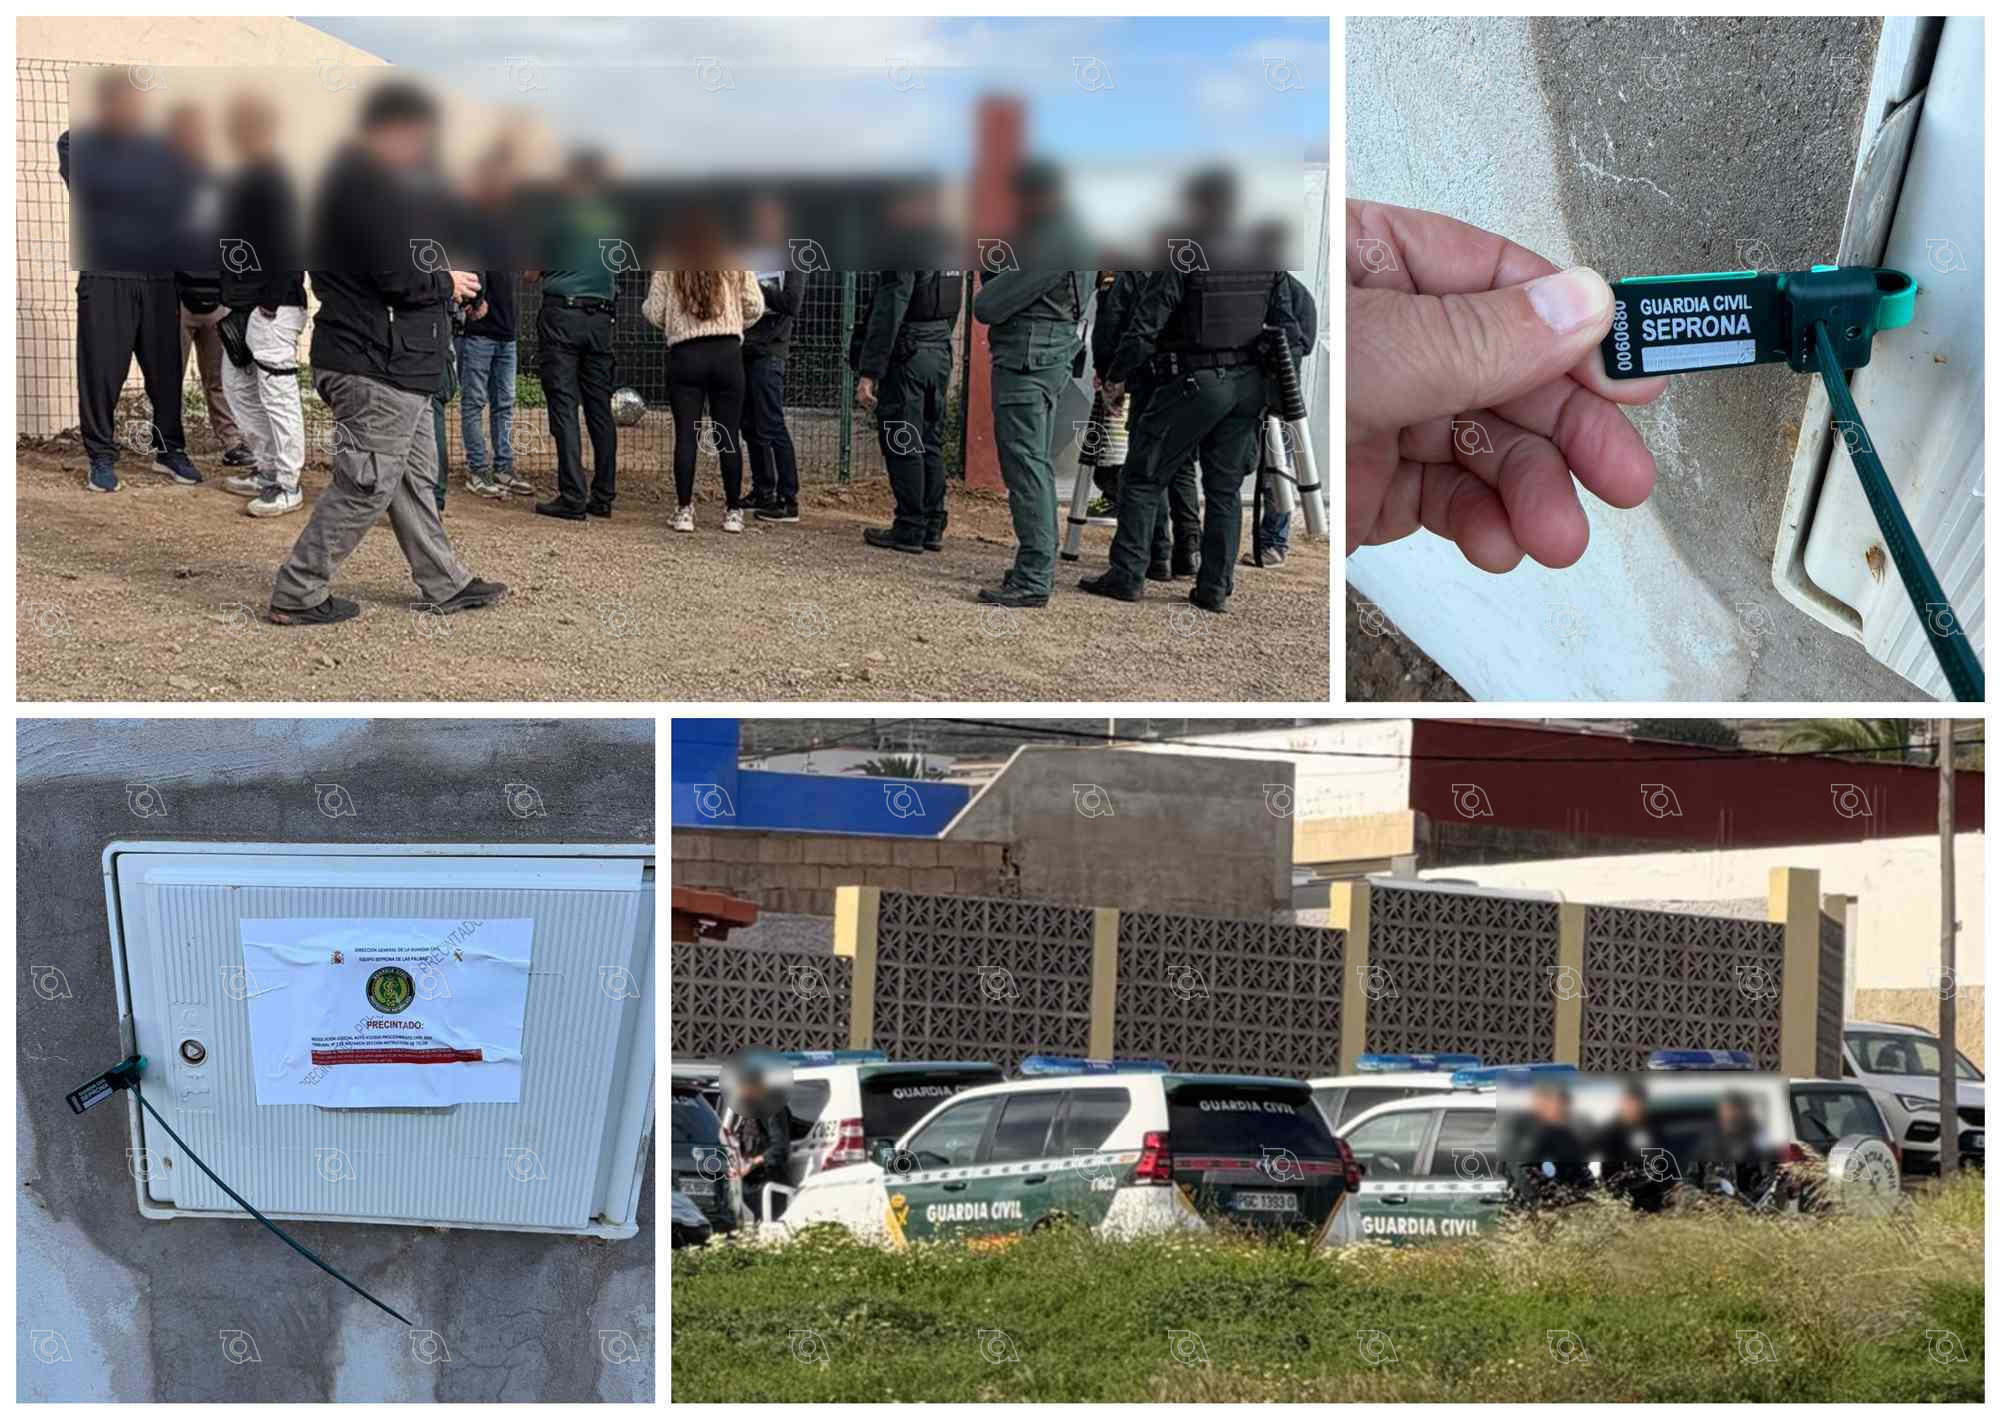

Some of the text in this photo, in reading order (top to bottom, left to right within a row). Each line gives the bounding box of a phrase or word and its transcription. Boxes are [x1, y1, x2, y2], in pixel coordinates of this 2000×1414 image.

[1640, 294, 1752, 316] GUARDIA CIVIL
[1641, 313, 1751, 341] SEPRONA
[893, 1086, 952, 1099] GUARDIA
[1200, 1100, 1296, 1115] GUARDIA CIVIL
[926, 1200, 1023, 1222] GUARDIA CIVIL
[1361, 1216, 1479, 1236] GUARDIA CIVIL
